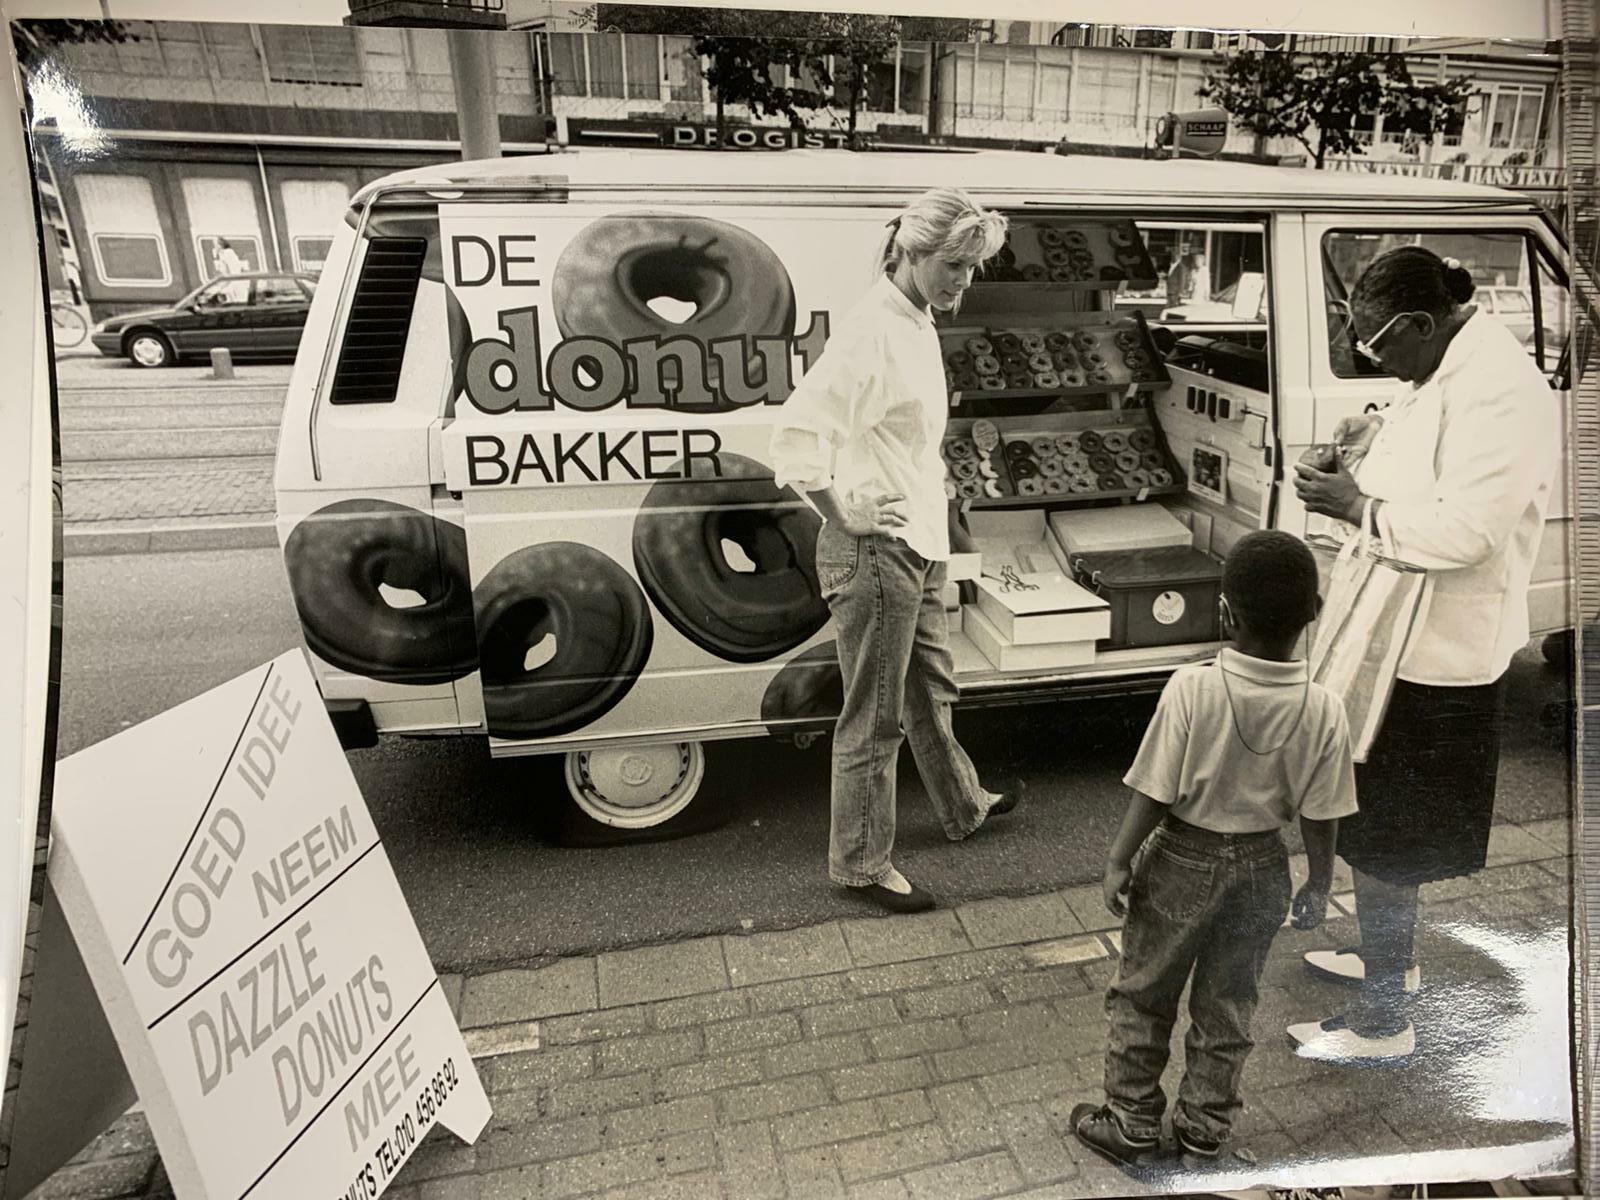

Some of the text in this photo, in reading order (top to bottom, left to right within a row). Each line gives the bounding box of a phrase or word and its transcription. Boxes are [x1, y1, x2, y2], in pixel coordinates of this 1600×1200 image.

[1468, 166, 1514, 186] HANS
[451, 234, 541, 288] DE
[465, 428, 724, 486] BAKKER
[145, 675, 302, 989] GOED IDEE
[251, 804, 358, 919] NEEM
[186, 921, 328, 1097] DAZZLE
[270, 953, 394, 1127] DONUTS
[343, 1033, 422, 1153] MEE
